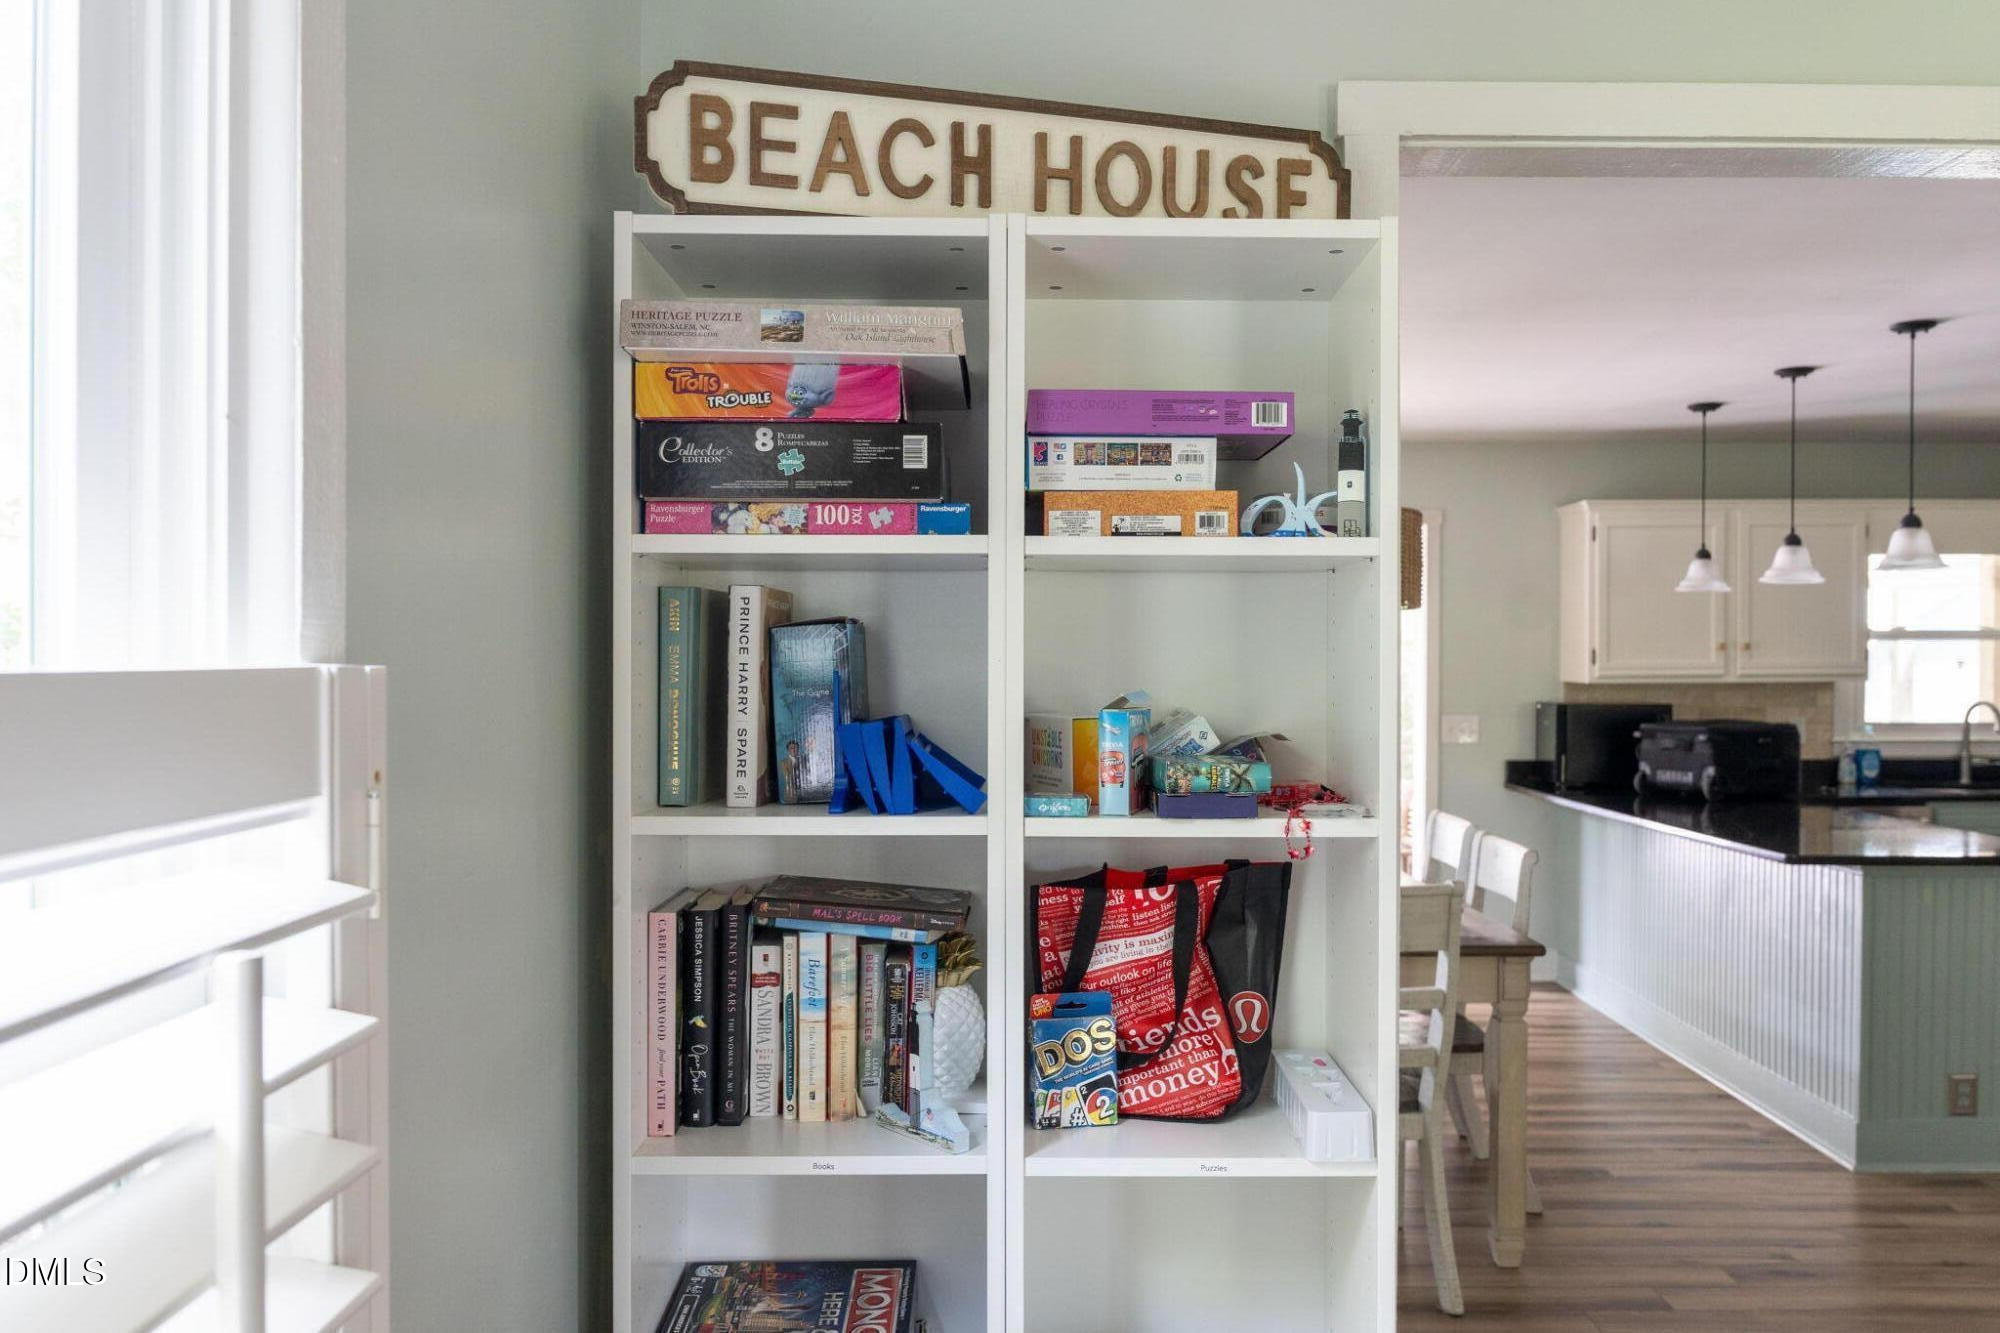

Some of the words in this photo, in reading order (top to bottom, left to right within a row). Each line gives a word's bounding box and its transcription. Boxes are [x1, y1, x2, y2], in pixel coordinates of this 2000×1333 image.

[689, 93, 992, 208] BEACH
[1033, 131, 1312, 219] HOUSE
[631, 310, 691, 320] HERITAGE
[696, 312, 743, 321] PUZZLE
[667, 371, 719, 392] Trolls
[707, 392, 772, 408] TROUBLE
[659, 436, 733, 463] Collector's
[755, 427, 775, 452] 8
[650, 504, 705, 514] Ravensburger
[650, 514, 676, 523] Puzzle
[815, 504, 850, 525] 100
[851, 506, 863, 525] XXL
[920, 505, 967, 513] Ravensburger
[739, 596, 750, 655] PRINCE
[738, 662, 749, 716] HARRY
[736, 728, 748, 778] SPARE
[811, 907, 842, 919] MAL'S
[846, 910, 875, 922] SPELL
[878, 914, 902, 924] BOOK
[1132, 908, 1160, 920] listen
[656, 919, 667, 962] CARRIE
[695, 915, 704, 956] JESSICA
[728, 914, 738, 967] BRITNEY
[1124, 940, 1135, 949] is
[865, 954, 874, 972] BIG
[1100, 967, 1139, 986] outlook
[1141, 966, 1156, 976] on
[1157, 959, 1172, 971] life
[694, 958, 703, 1002] SIMPSON
[727, 968, 737, 1013] SPEARS
[805, 959, 820, 1007] Barefoot
[864, 976, 873, 1012] LITTLE
[914, 967, 924, 1003] KELLERMA
[1120, 986, 1136, 996] like
[656, 963, 667, 1041] UNDERWOOD
[756, 990, 774, 1044] SANDRA
[1034, 1005, 1052, 1017] UNO
[864, 1017, 873, 1042] LIES
[1117, 1005, 1222, 1052] riends
[727, 1035, 735, 1069] WOMAN
[1034, 1019, 1117, 1077] DOS
[1119, 1060, 1185, 1086] mportant
[1187, 1049, 1219, 1065] than
[656, 1079, 667, 1110] PATH
[755, 1063, 773, 1113] BROWN
[1081, 1086, 1088, 1095] 2
[1118, 1060, 1220, 1109] money
[1096, 1095, 1114, 1120] 2
[812, 1162, 835, 1170] Books
[1200, 1164, 1228, 1172] Puzzles
[820, 1291, 846, 1327] HERE
